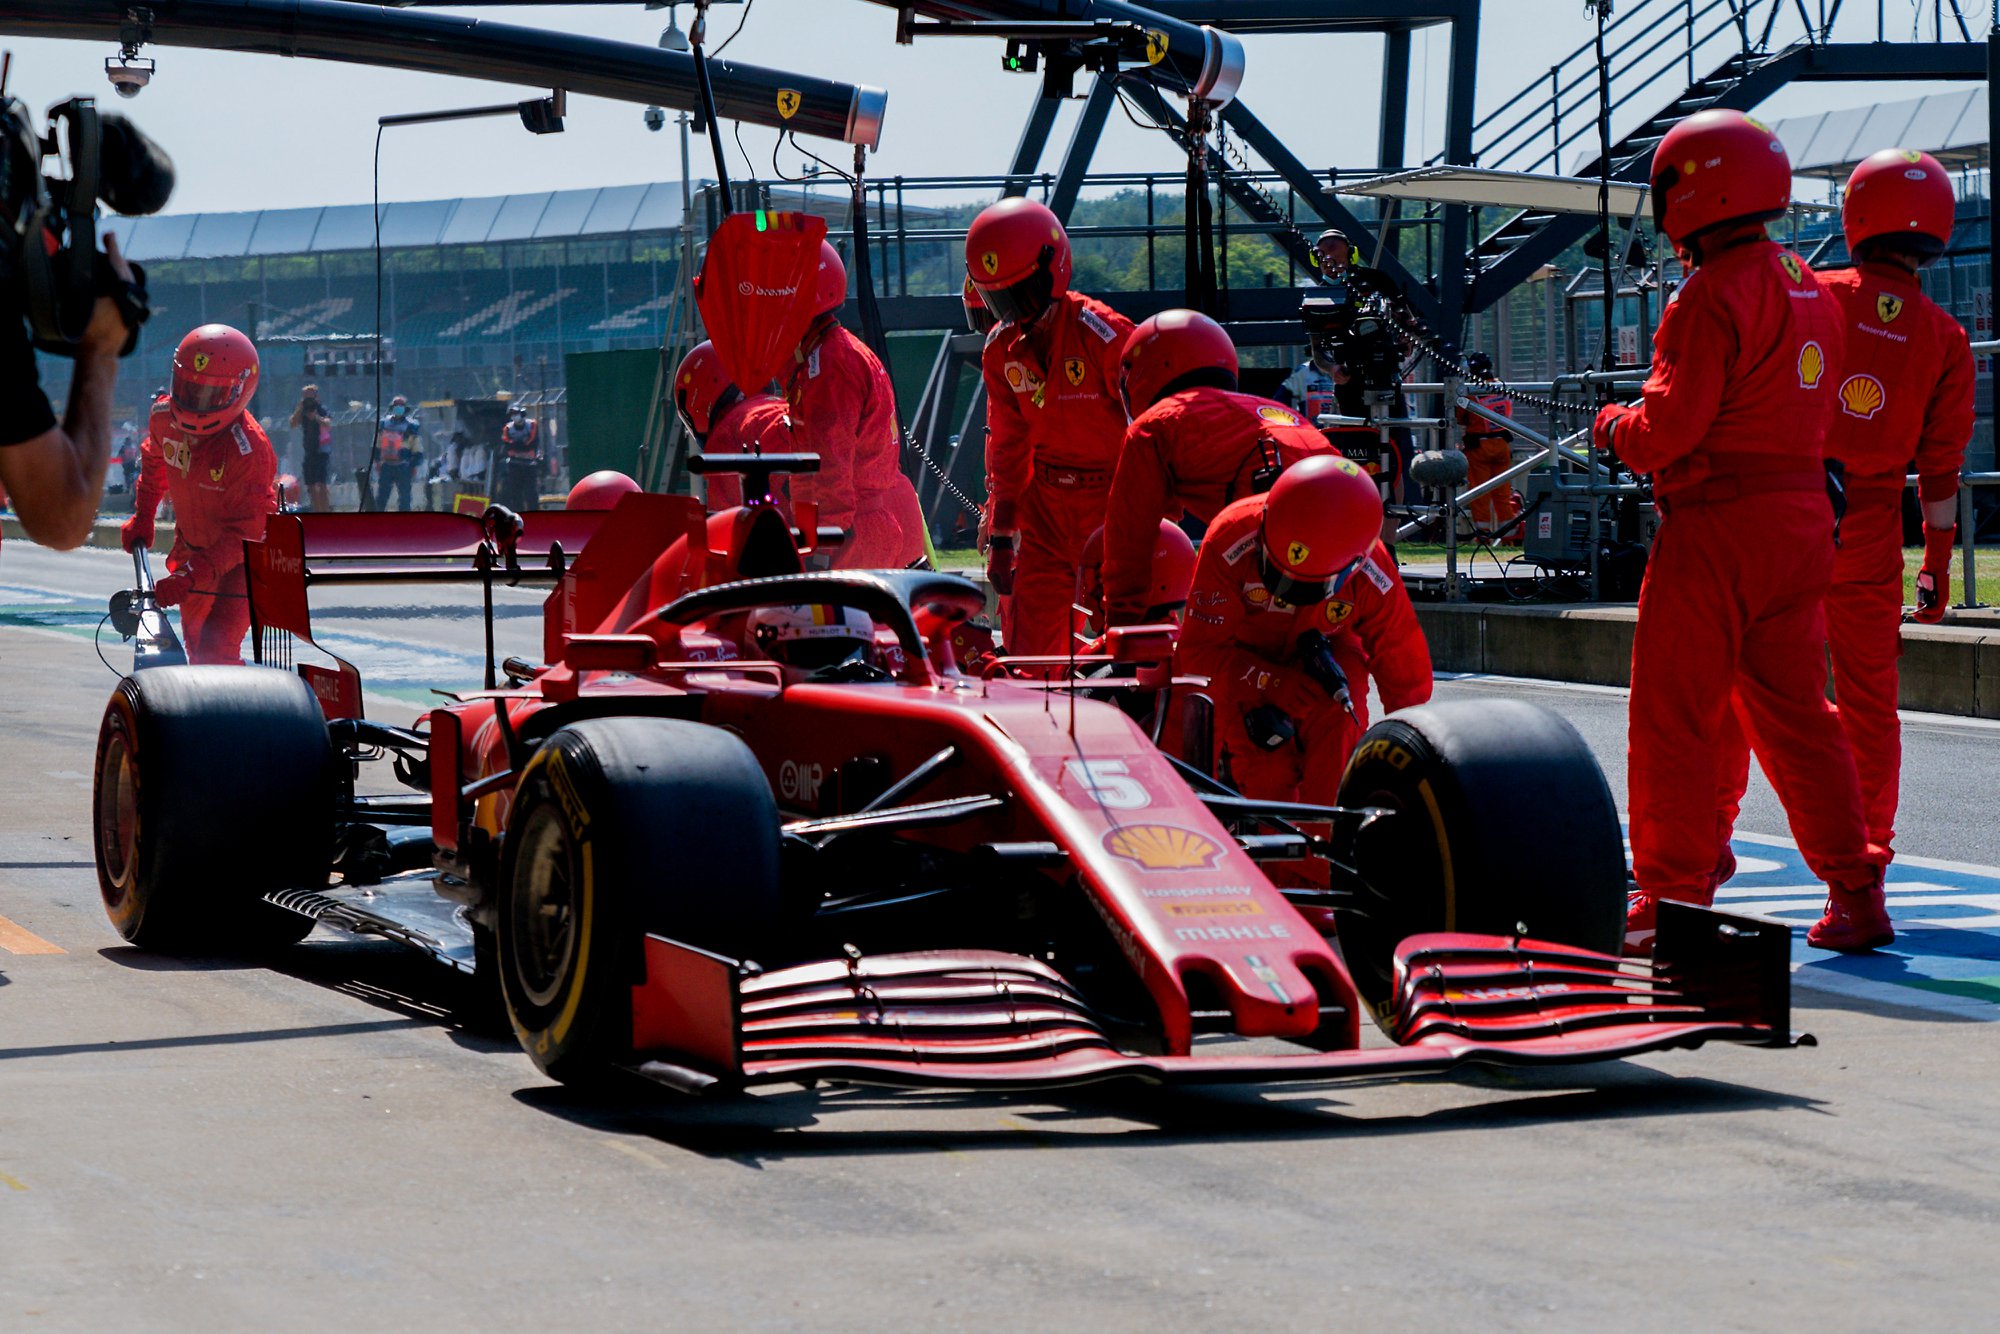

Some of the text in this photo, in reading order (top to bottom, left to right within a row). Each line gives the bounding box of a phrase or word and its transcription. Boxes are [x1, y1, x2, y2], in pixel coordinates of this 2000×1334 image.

[1225, 536, 1256, 562] kasper
[1064, 759, 1152, 810] 5
[1141, 885, 1252, 899] kaspersky
[1173, 923, 1291, 941] MAHLE
